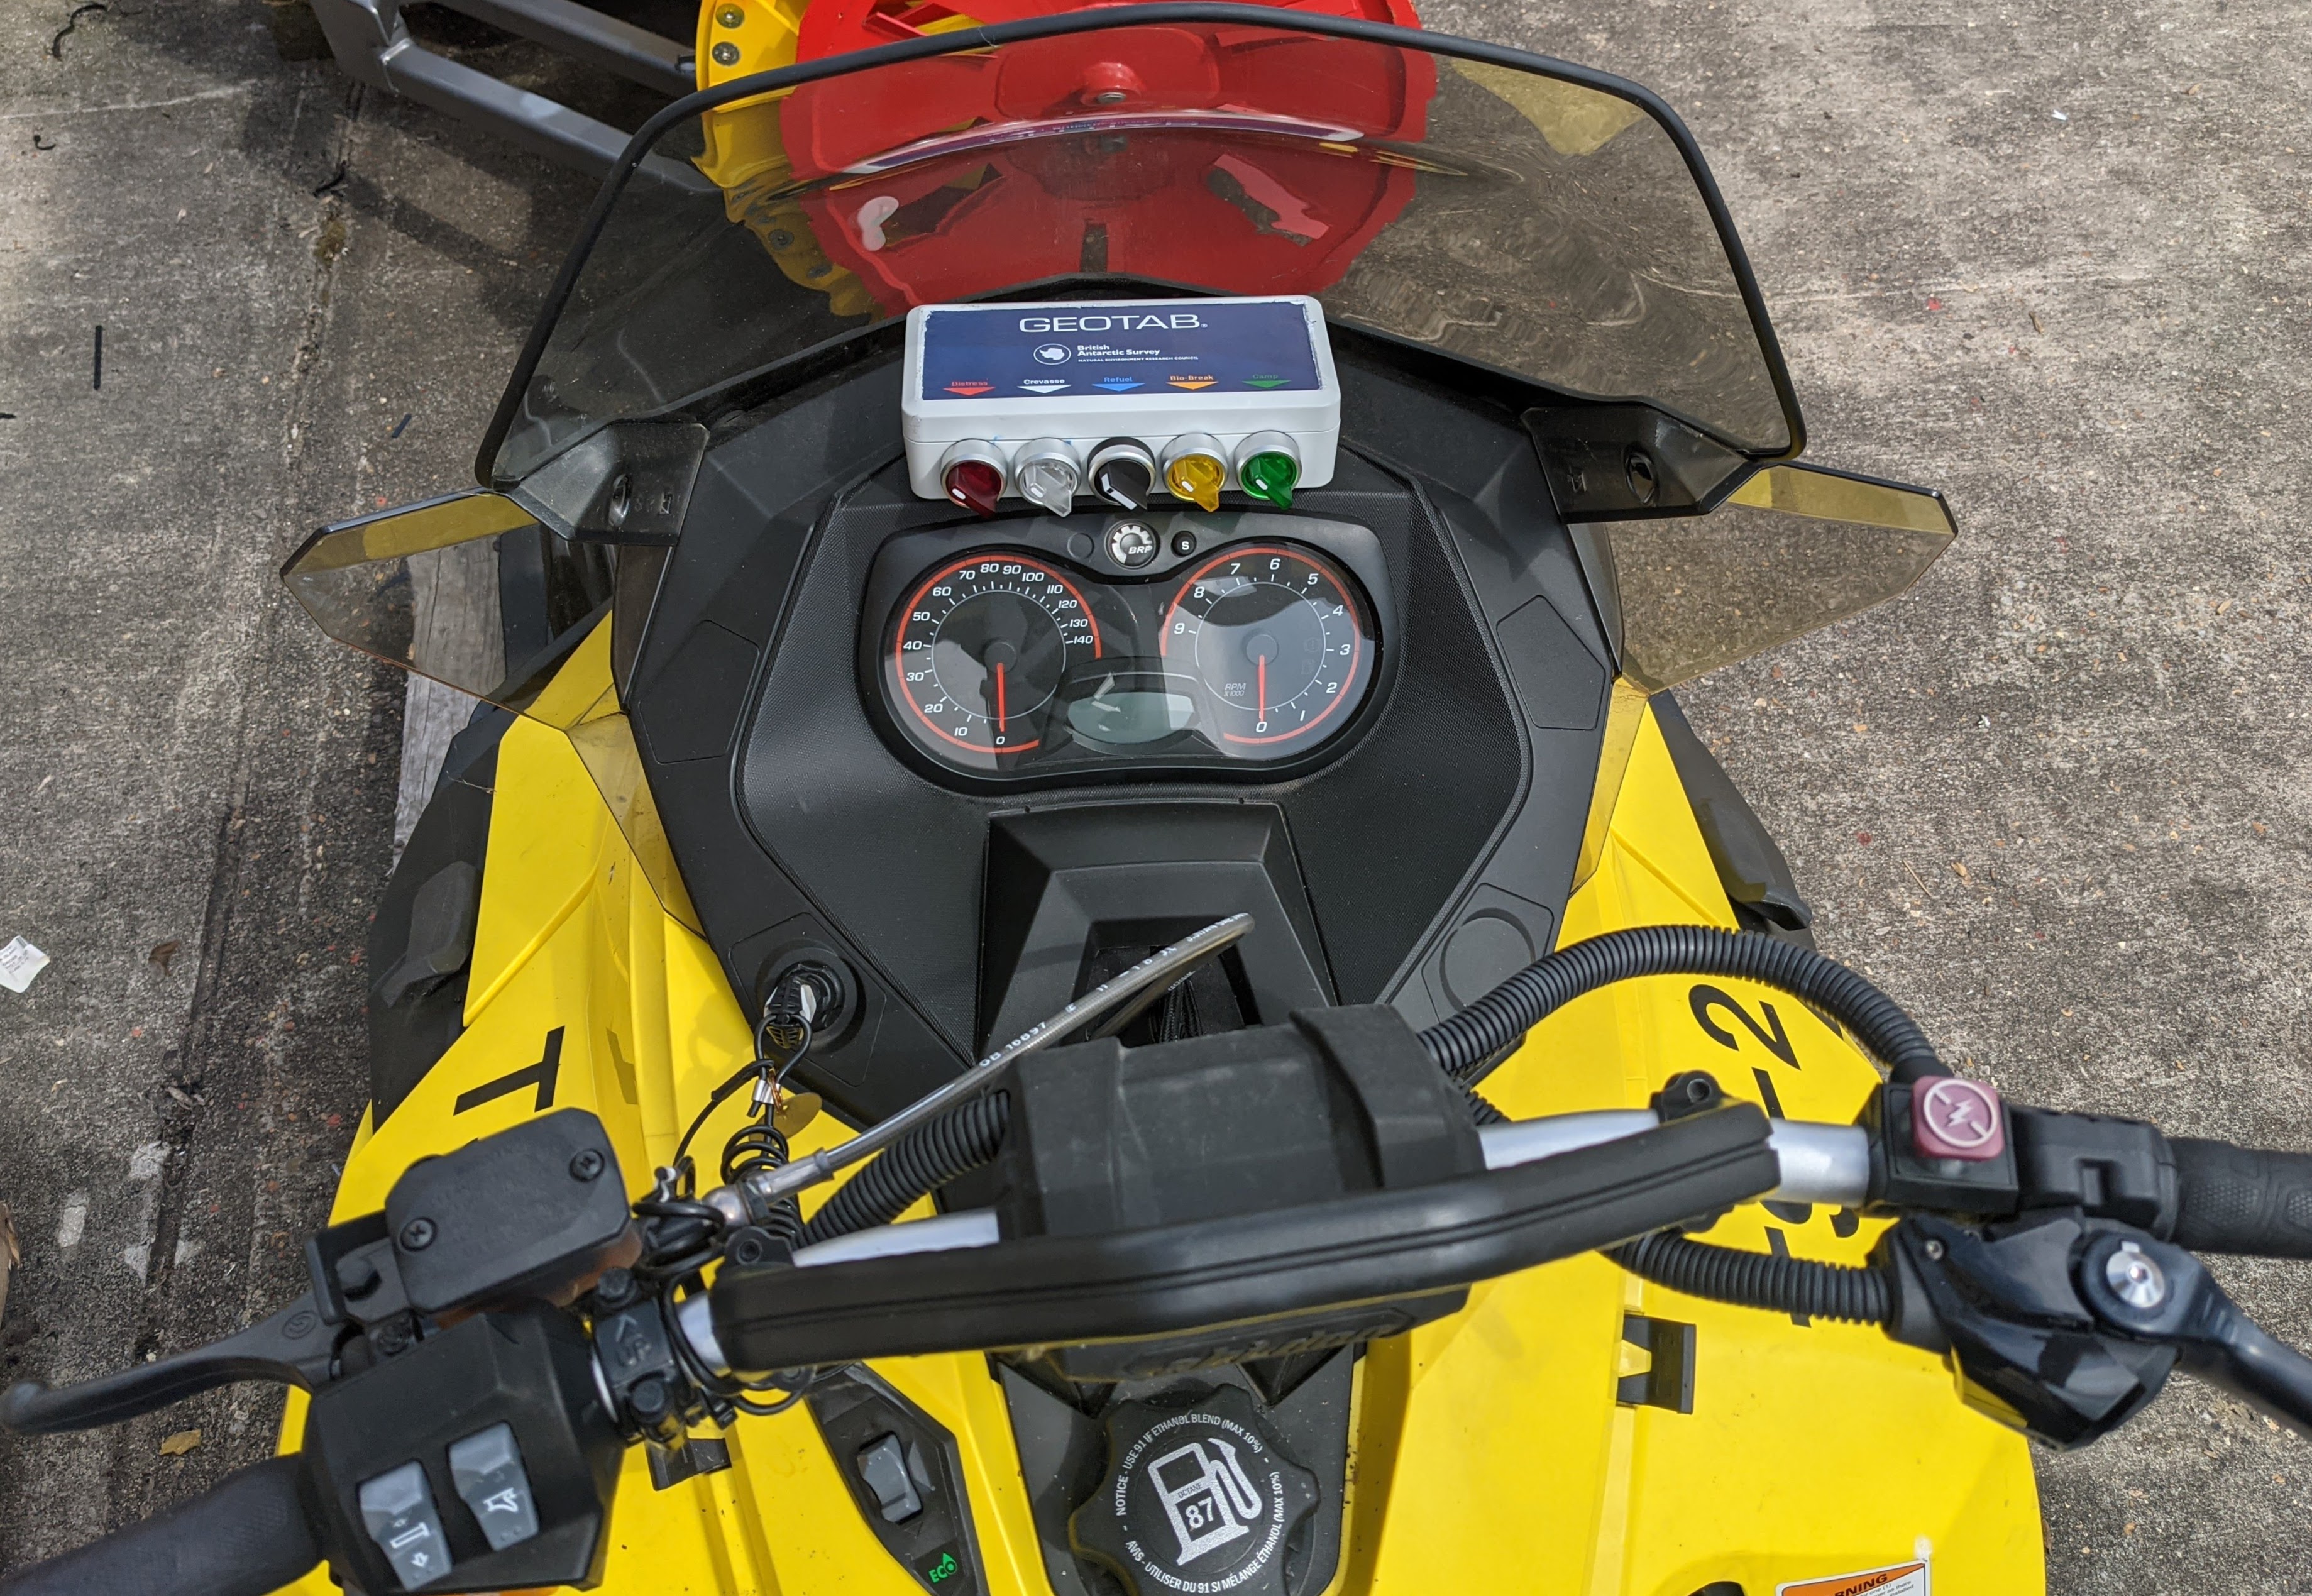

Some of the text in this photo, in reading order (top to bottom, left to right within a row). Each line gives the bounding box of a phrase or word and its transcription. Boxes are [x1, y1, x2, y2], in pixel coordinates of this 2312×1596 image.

[1128, 545, 1152, 554] BRP
[980, 564, 999, 573] 80
[1230, 563, 1240, 575] 7
[1270, 558, 1280, 570] 6
[1003, 564, 1021, 575] 90
[959, 570, 976, 580] 70
[1022, 572, 1044, 582] 100
[1307, 573, 1319, 585] 5
[932, 586, 951, 596] 60
[1047, 585, 1063, 594] 110
[1194, 586, 1204, 598] 8
[1058, 600, 1077, 609] 120
[1333, 605, 1343, 616] 4
[913, 612, 930, 621] 50
[1070, 619, 1088, 628] 130
[1174, 623, 1185, 634] 9
[1074, 635, 1093, 644] 140
[903, 641, 922, 651] 40
[1340, 644, 1350, 654] 3
[906, 671, 924, 681] 30
[1326, 683, 1337, 693] 2
[924, 703, 943, 713] 20
[1300, 710, 1305, 721] 1
[954, 727, 967, 736] 10
[1256, 722, 1267, 732] 0
[996, 736, 1005, 744] 0
[1115, 1414, 1263, 1516] NOTICE USE 91 IF ETHANOL BLEND (MAX 10%)
[1177, 1482, 1202, 1498] OCTANE
[1186, 1497, 1213, 1528] 87
[1125, 1472, 1285, 1593] AVIS UTILISER DU 91 SI MÉLANGE ÉTHANOL (MAX 10%)
[928, 1554, 957, 1583] ECO
